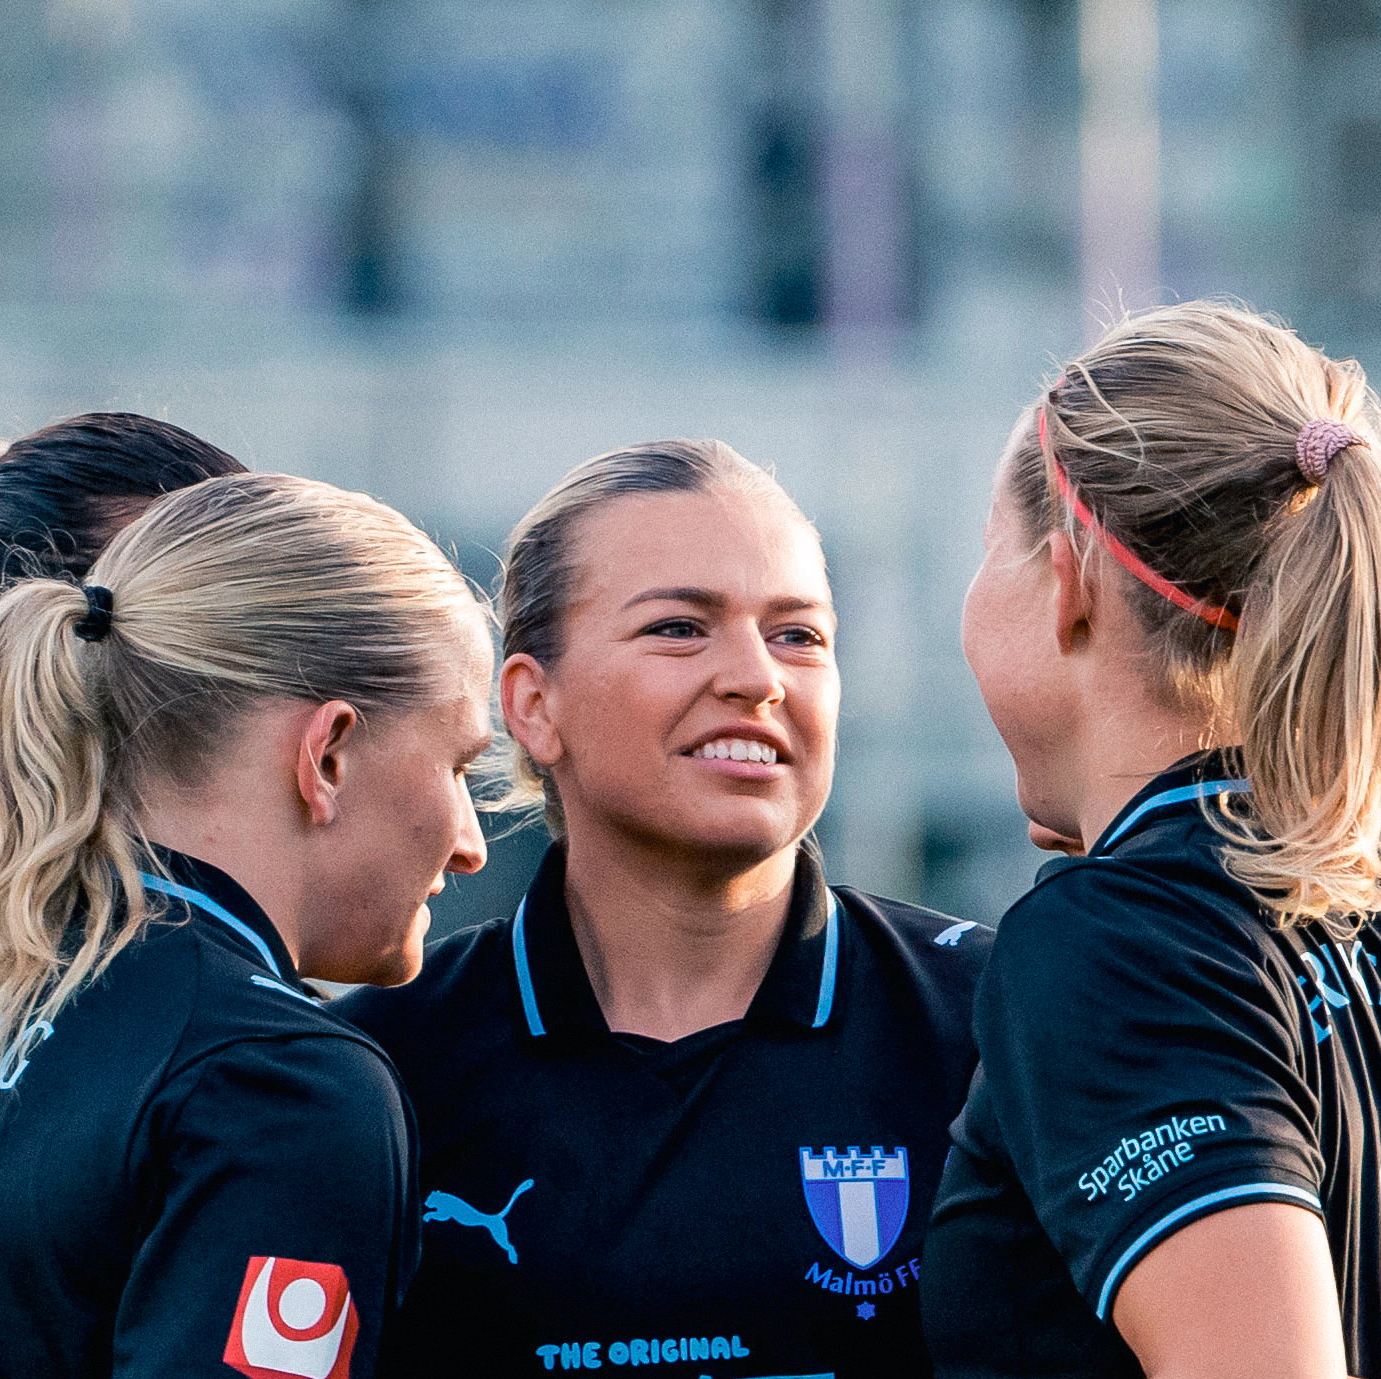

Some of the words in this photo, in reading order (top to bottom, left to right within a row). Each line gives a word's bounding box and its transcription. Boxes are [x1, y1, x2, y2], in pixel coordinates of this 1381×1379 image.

[1078, 1114, 1227, 1201] Sparbanken
[1119, 1141, 1196, 1202] Skåne
[804, 1261, 894, 1296] Malmö
[895, 1257, 921, 1288] FF
[536, 1342, 602, 1370] THE
[608, 1335, 750, 1367] ORIGINAL
